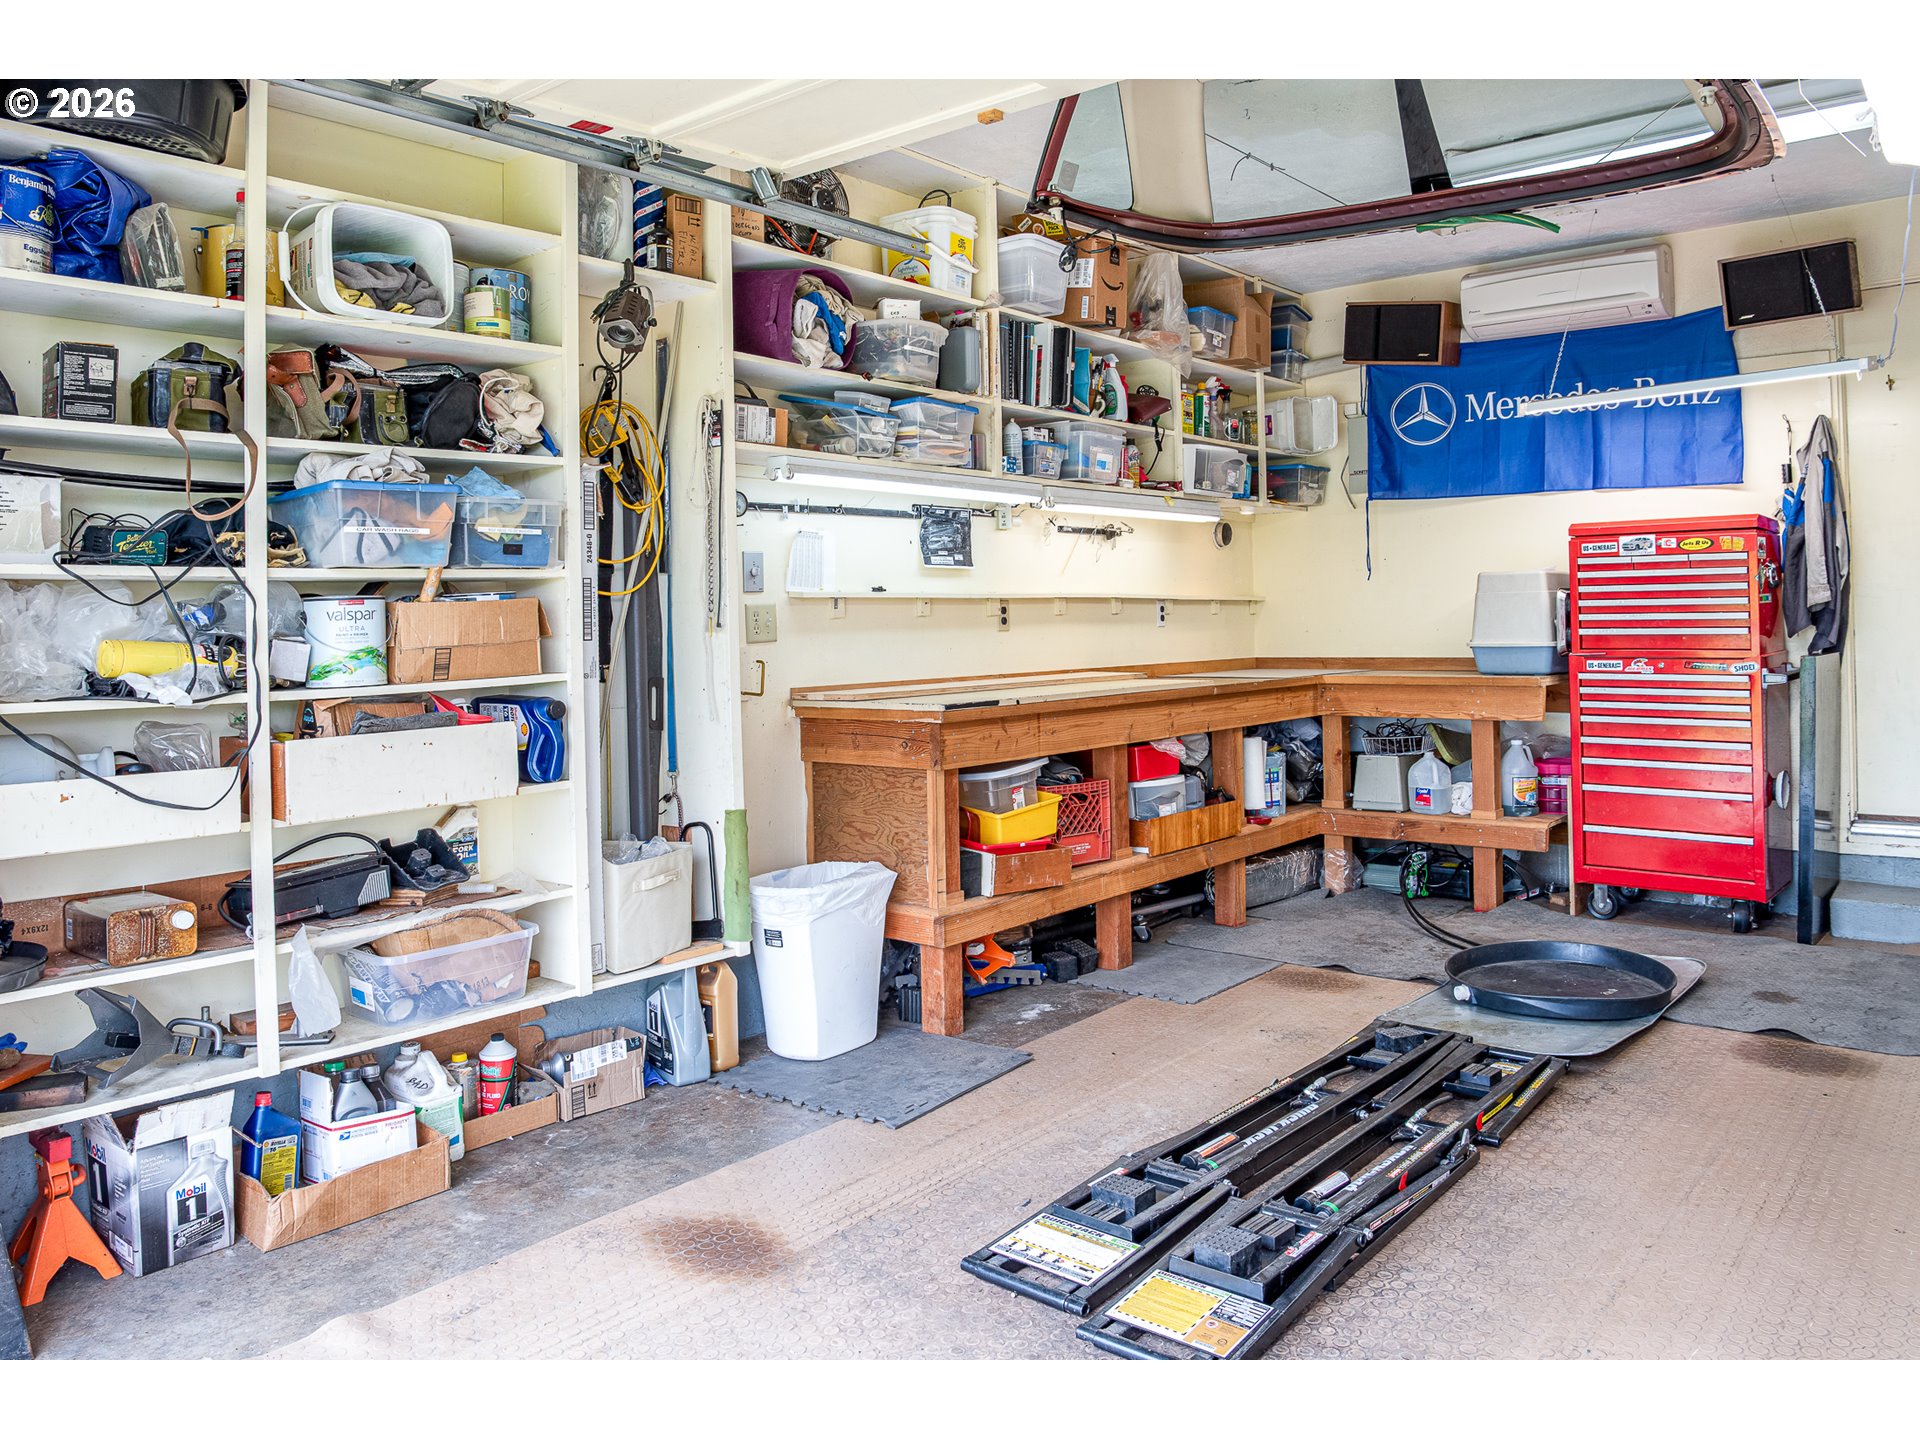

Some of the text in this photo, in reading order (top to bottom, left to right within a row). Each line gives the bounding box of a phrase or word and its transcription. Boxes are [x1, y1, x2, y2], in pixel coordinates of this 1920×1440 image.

[8, 173, 47, 192] Benjamin
[638, 188, 650, 196] BOSCH
[635, 209, 647, 217] BOSCH
[677, 230, 688, 267] FILTERS
[1633, 376, 1721, 409] Benz
[326, 606, 376, 624] valspar
[338, 625, 366, 633] ULTRA
[1734, 663, 1755, 672] SHOEI
[452, 844, 474, 853] FORK
[20, 924, 50, 936] 12X9X4
[405, 1077, 429, 1090] BAD
[385, 1119, 408, 1127] PRIORITY
[85, 1136, 107, 1163] Mobil
[92, 1162, 103, 1204] 1
[176, 1182, 207, 1200] Mobil
[185, 1197, 197, 1221] 1
[1041, 1213, 1105, 1238] QUICKJACK
